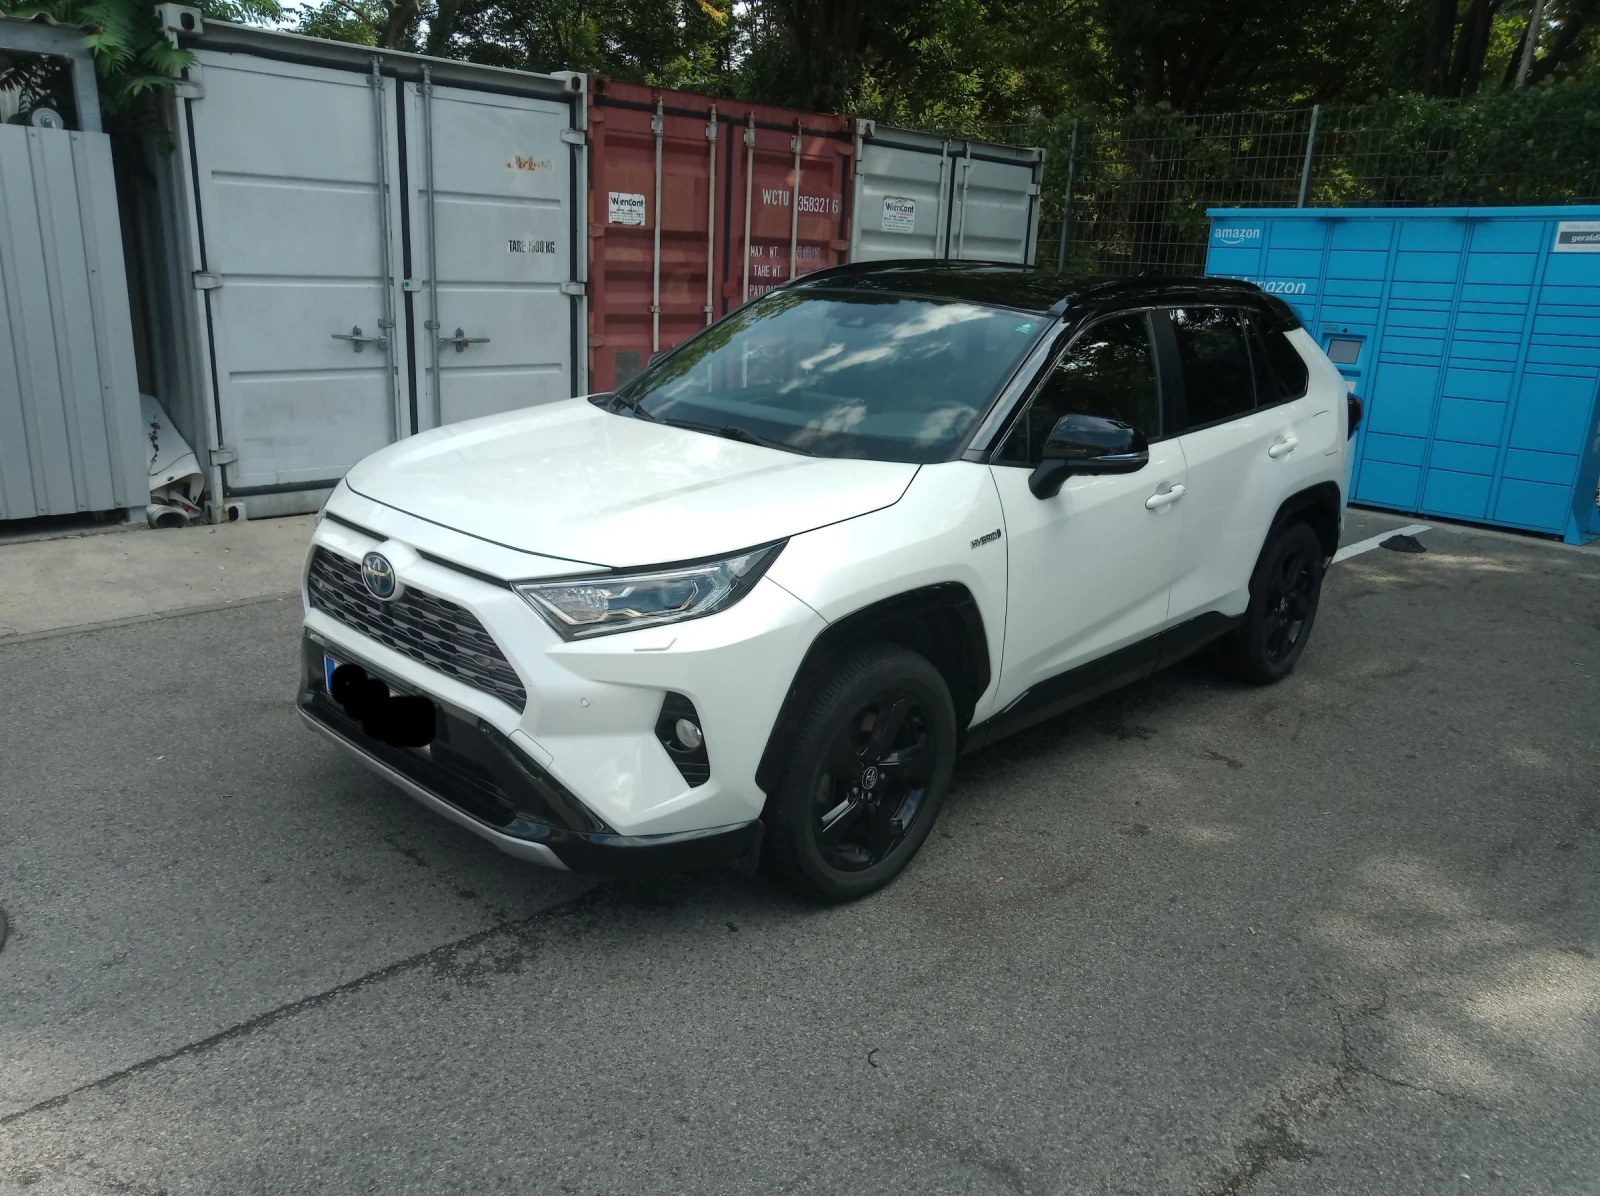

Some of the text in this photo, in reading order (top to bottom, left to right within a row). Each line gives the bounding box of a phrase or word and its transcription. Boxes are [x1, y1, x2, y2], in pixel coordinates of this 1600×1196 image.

[610, 196, 644, 207] WenCont
[763, 188, 839, 214] WCTU 358321 6
[1214, 228, 1260, 240] amazon
[508, 240, 525, 253] TARE
[545, 241, 555, 254] KG
[750, 245, 765, 258] MAX.
[753, 264, 770, 277] TARE
[749, 284, 777, 297] PAYLO
[969, 528, 1002, 550] HYBRID
